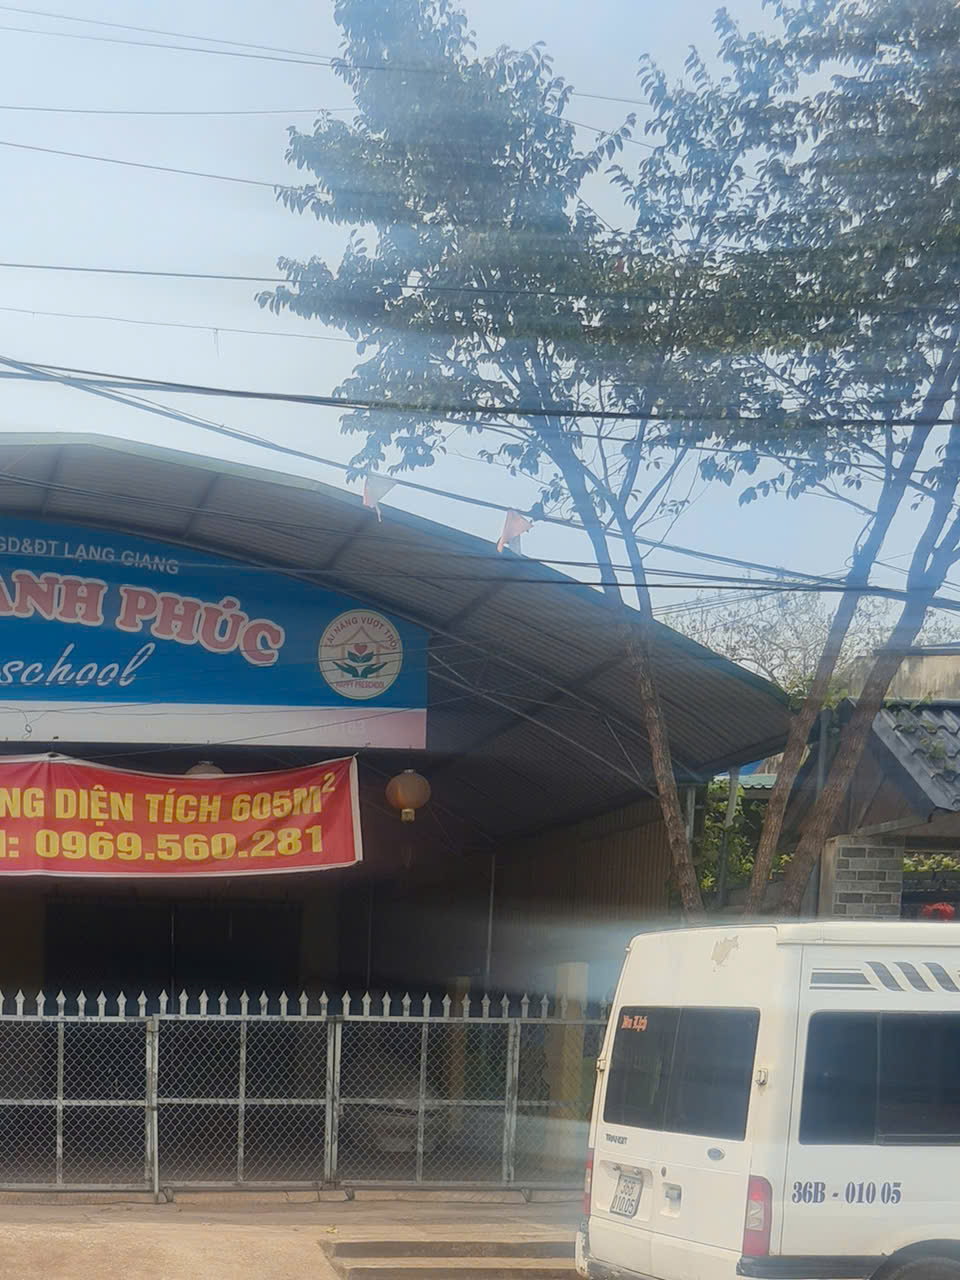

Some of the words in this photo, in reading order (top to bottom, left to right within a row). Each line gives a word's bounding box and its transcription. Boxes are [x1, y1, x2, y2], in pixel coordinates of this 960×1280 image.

[63, 542, 115, 563] LẠNG
[120, 550, 180, 575] GIANG
[55, 784, 135, 827] DIỆN
[145, 789, 223, 824] TÍCH
[35, 825, 324, 862] 0969.560.281
[791, 1181, 826, 1204] 36B
